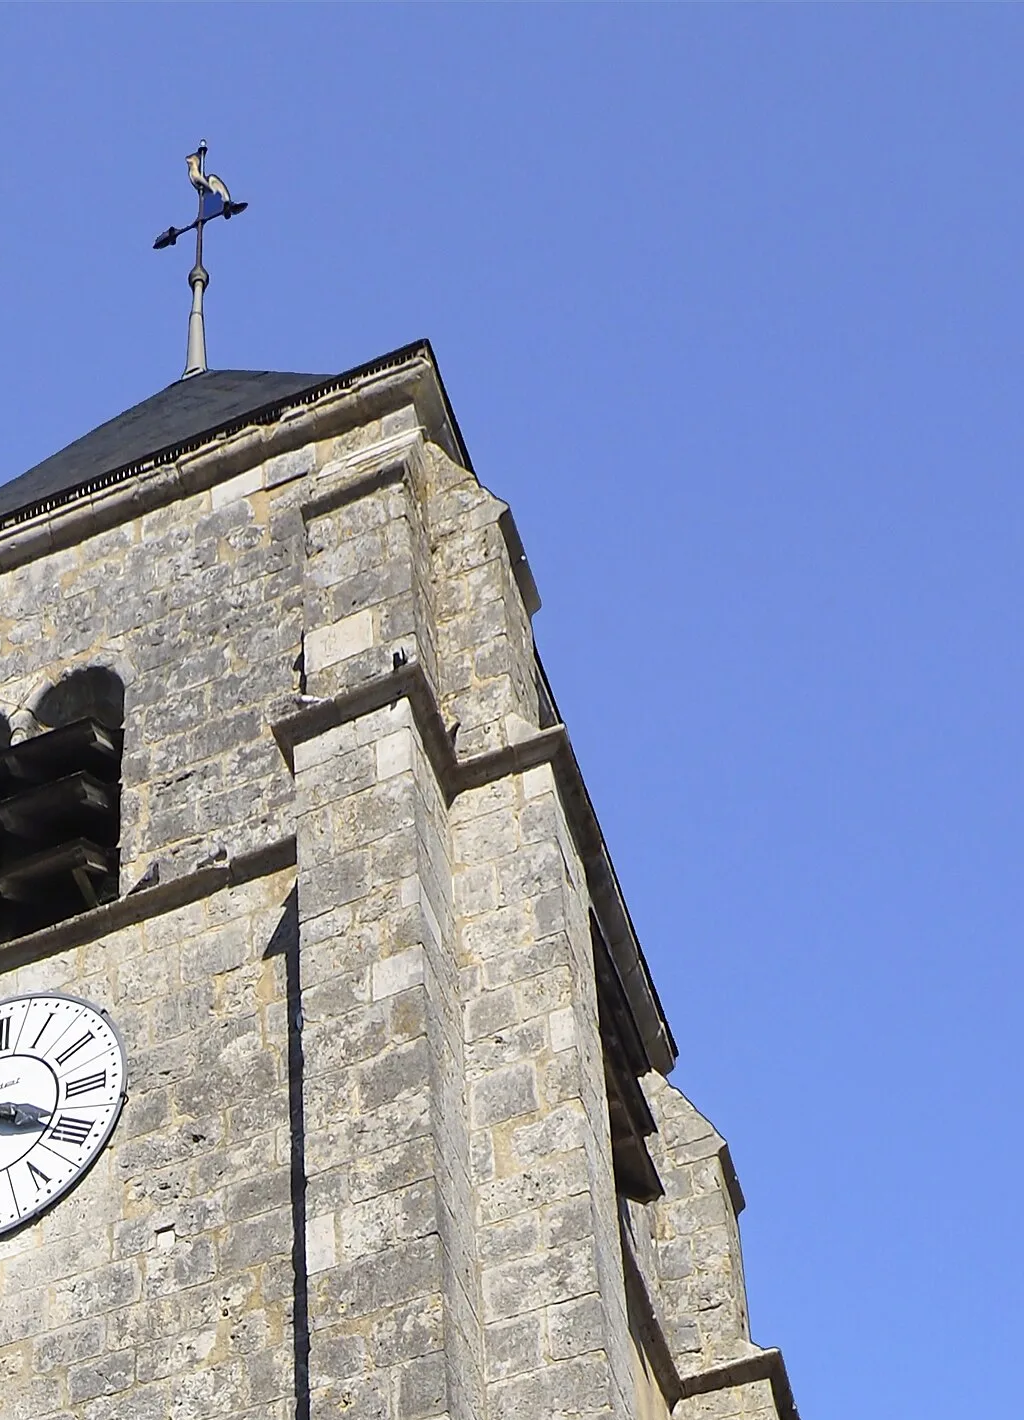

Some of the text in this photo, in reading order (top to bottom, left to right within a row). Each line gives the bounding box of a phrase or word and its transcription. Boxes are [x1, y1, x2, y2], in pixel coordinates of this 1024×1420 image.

[31, 1013, 55, 1049] I
[55, 1029, 96, 1067] II
[65, 1070, 107, 1099] III
[48, 1114, 97, 1146] IIII
[26, 1160, 53, 1191] V
